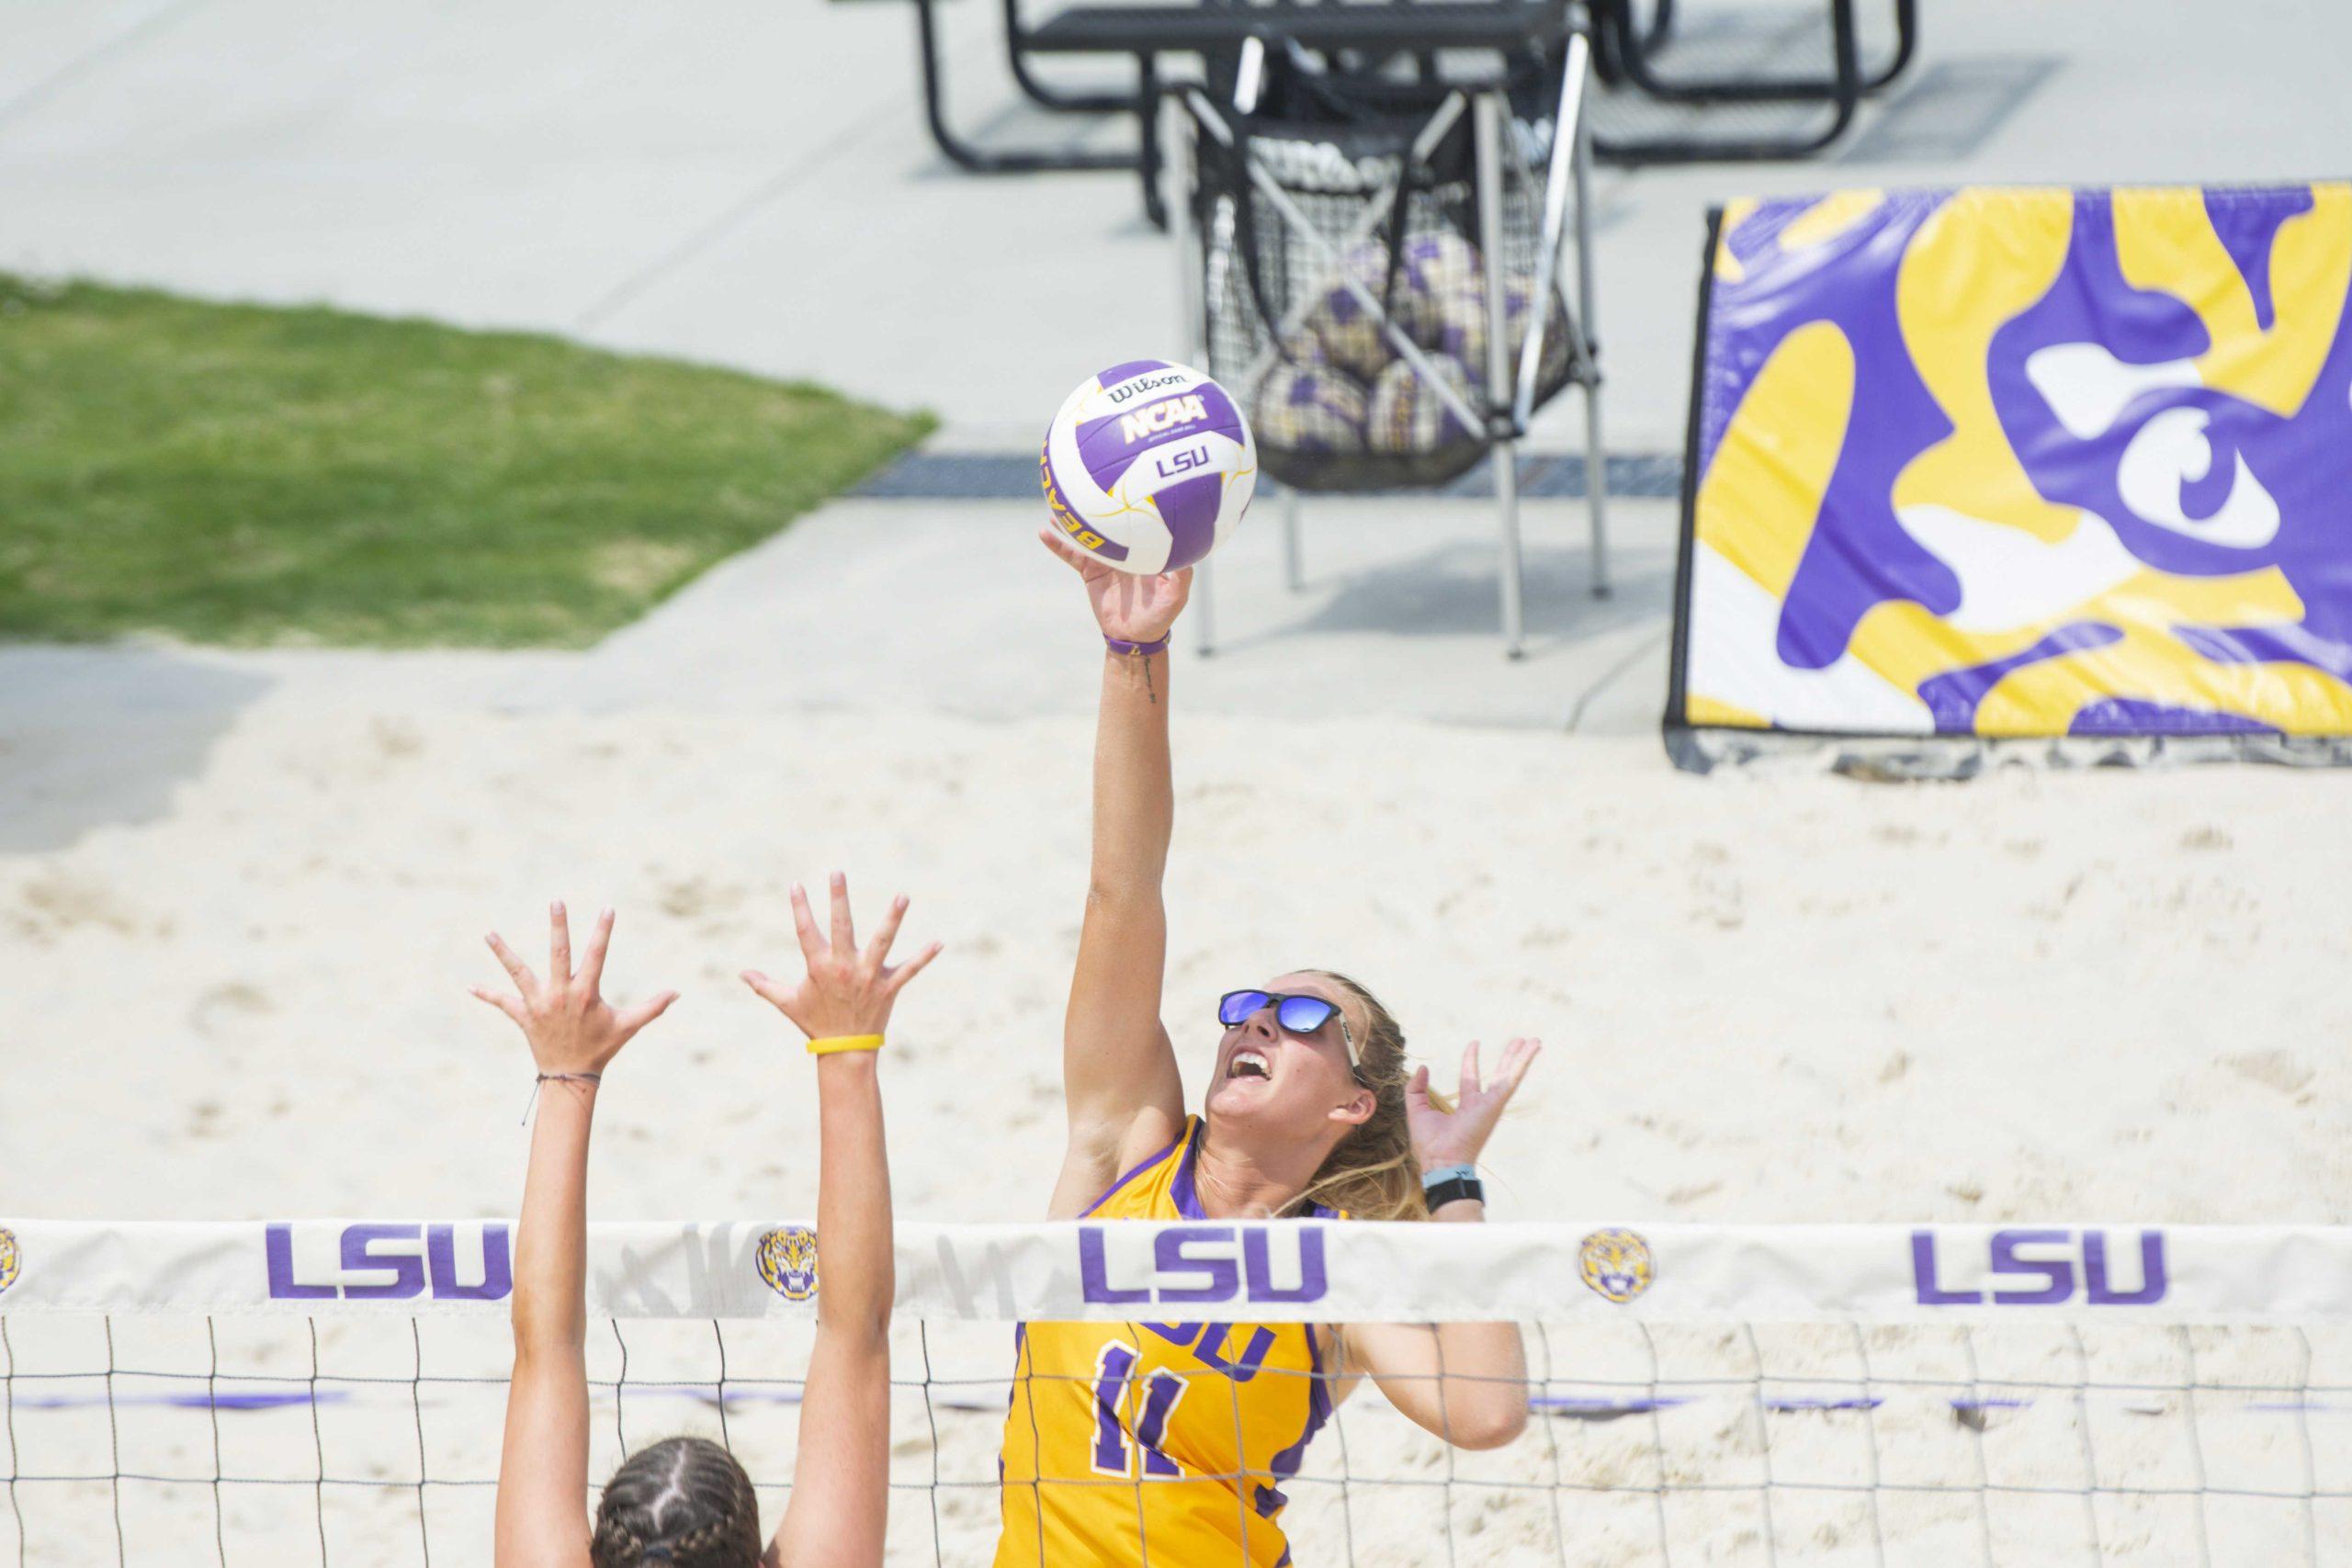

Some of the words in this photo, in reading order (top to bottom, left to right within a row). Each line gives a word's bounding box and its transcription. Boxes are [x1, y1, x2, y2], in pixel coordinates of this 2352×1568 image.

[1108, 375, 1188, 403] Wilson
[1120, 394, 1208, 446] NCAA
[1156, 446, 1209, 478] LSU
[266, 1224, 514, 1300] LSU
[1079, 1226, 1329, 1303] LSU
[1910, 1229, 2168, 1305] LSU
[1090, 1338, 1190, 1481] 11
